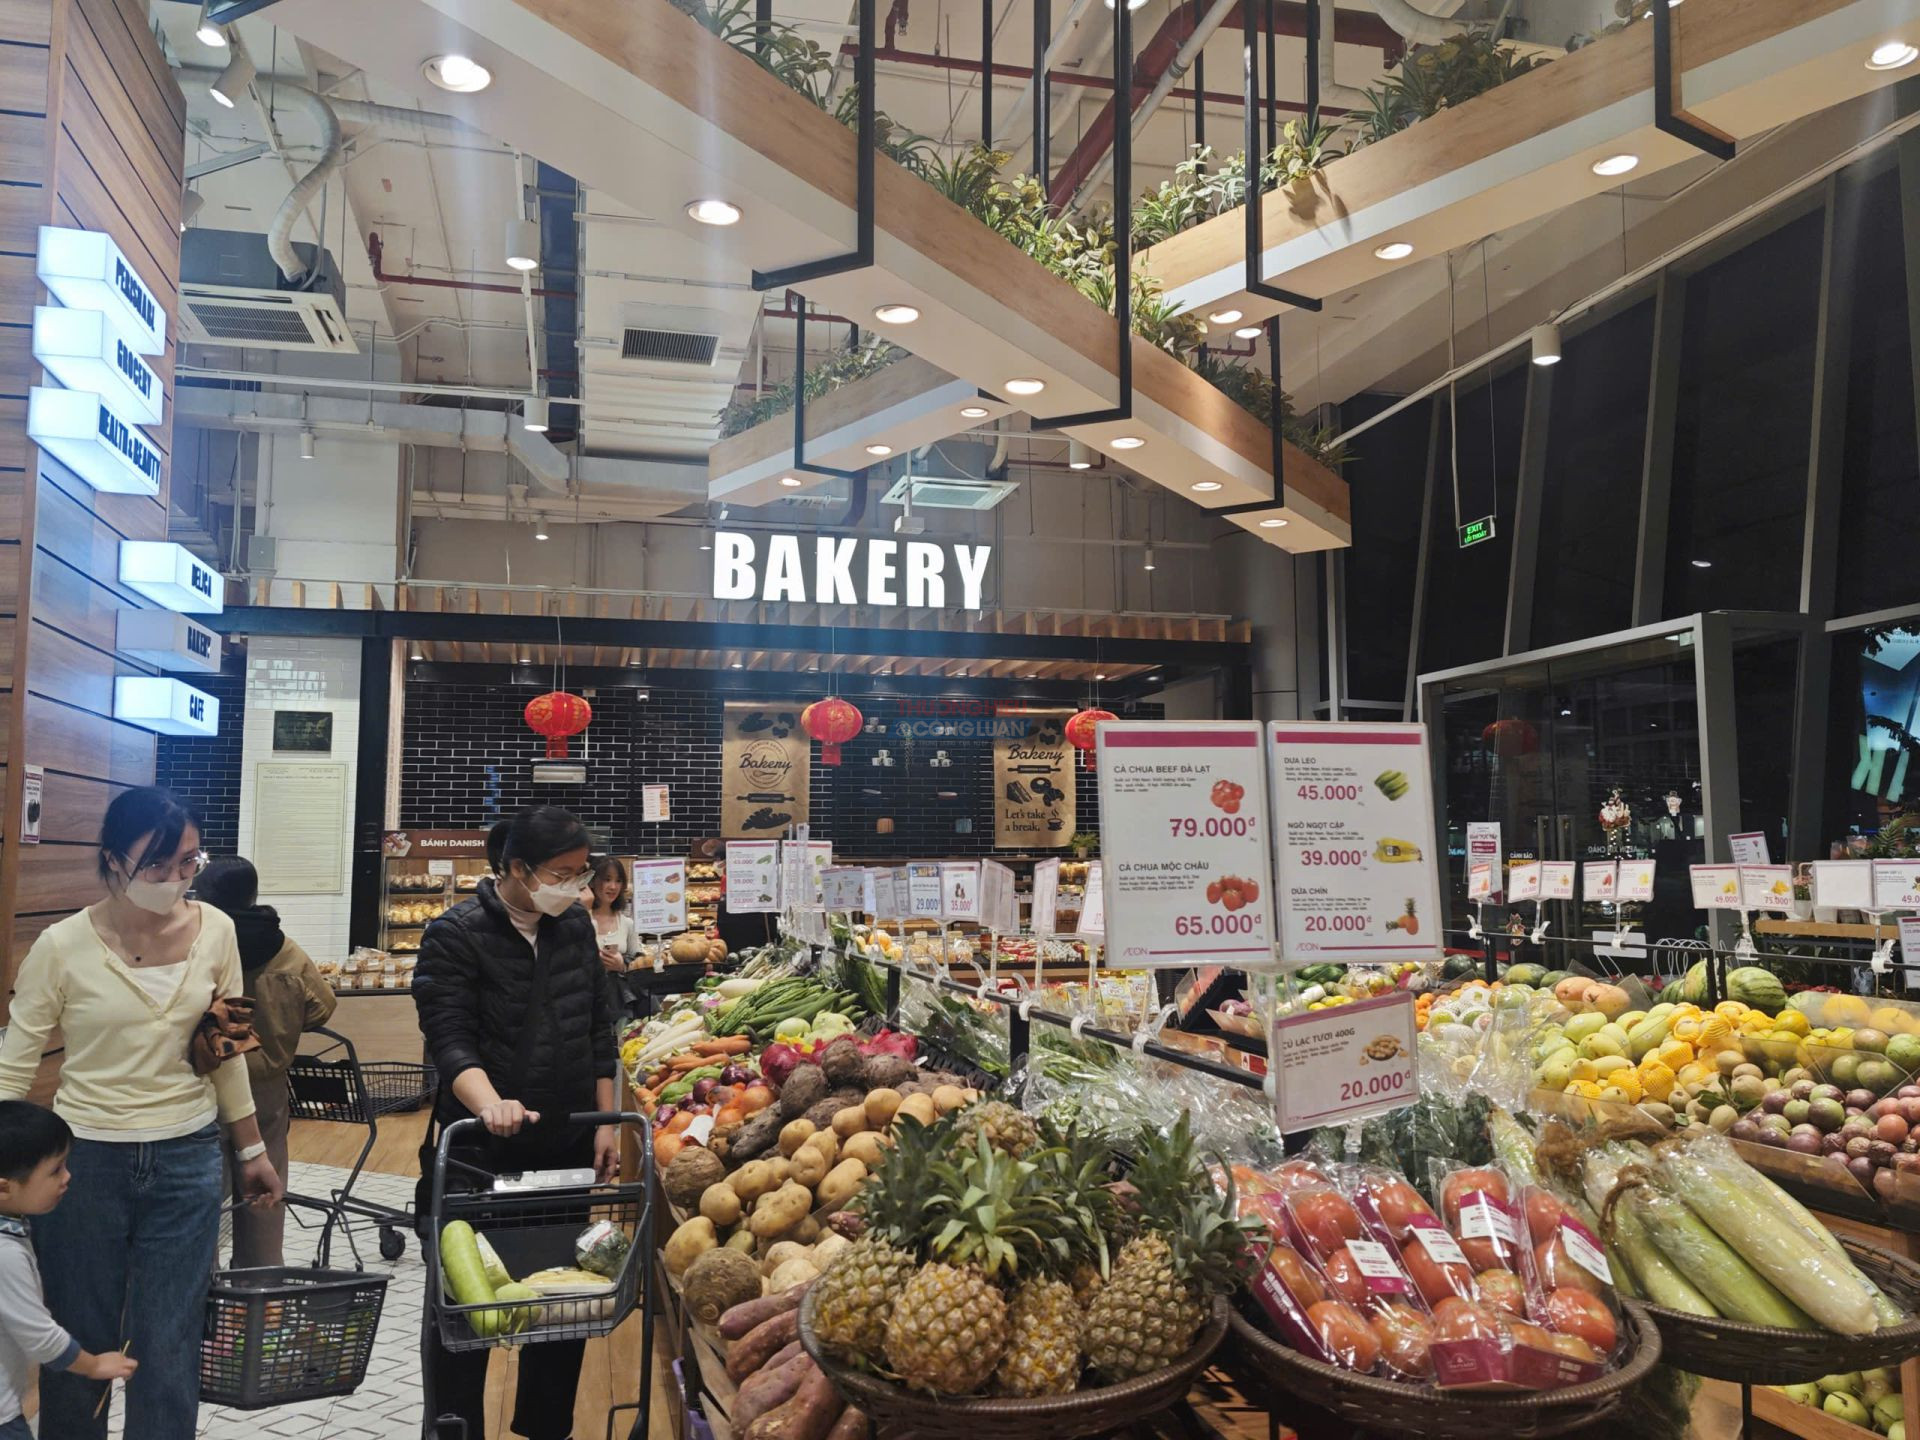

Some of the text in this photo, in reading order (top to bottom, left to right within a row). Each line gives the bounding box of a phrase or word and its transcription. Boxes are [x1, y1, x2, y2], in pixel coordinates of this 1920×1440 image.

[117, 338, 151, 400] GROCERY
[1466, 522, 1484, 535] EXIT
[713, 531, 992, 610] BAKERY
[189, 693, 205, 722] CAFE
[739, 752, 793, 775] Bakery
[1008, 744, 1064, 765] Bakery
[1128, 765, 1154, 773] CHUA
[1155, 765, 1179, 773] BEEF
[1005, 808, 1046, 819] Let's take
[1170, 817, 1256, 838] 79.000đ
[420, 838, 485, 847] BÁNH DANISH
[1133, 863, 1159, 871] CHUA
[1175, 914, 1262, 936] 65.000đ
[1335, 1027, 1355, 1038] 400G
